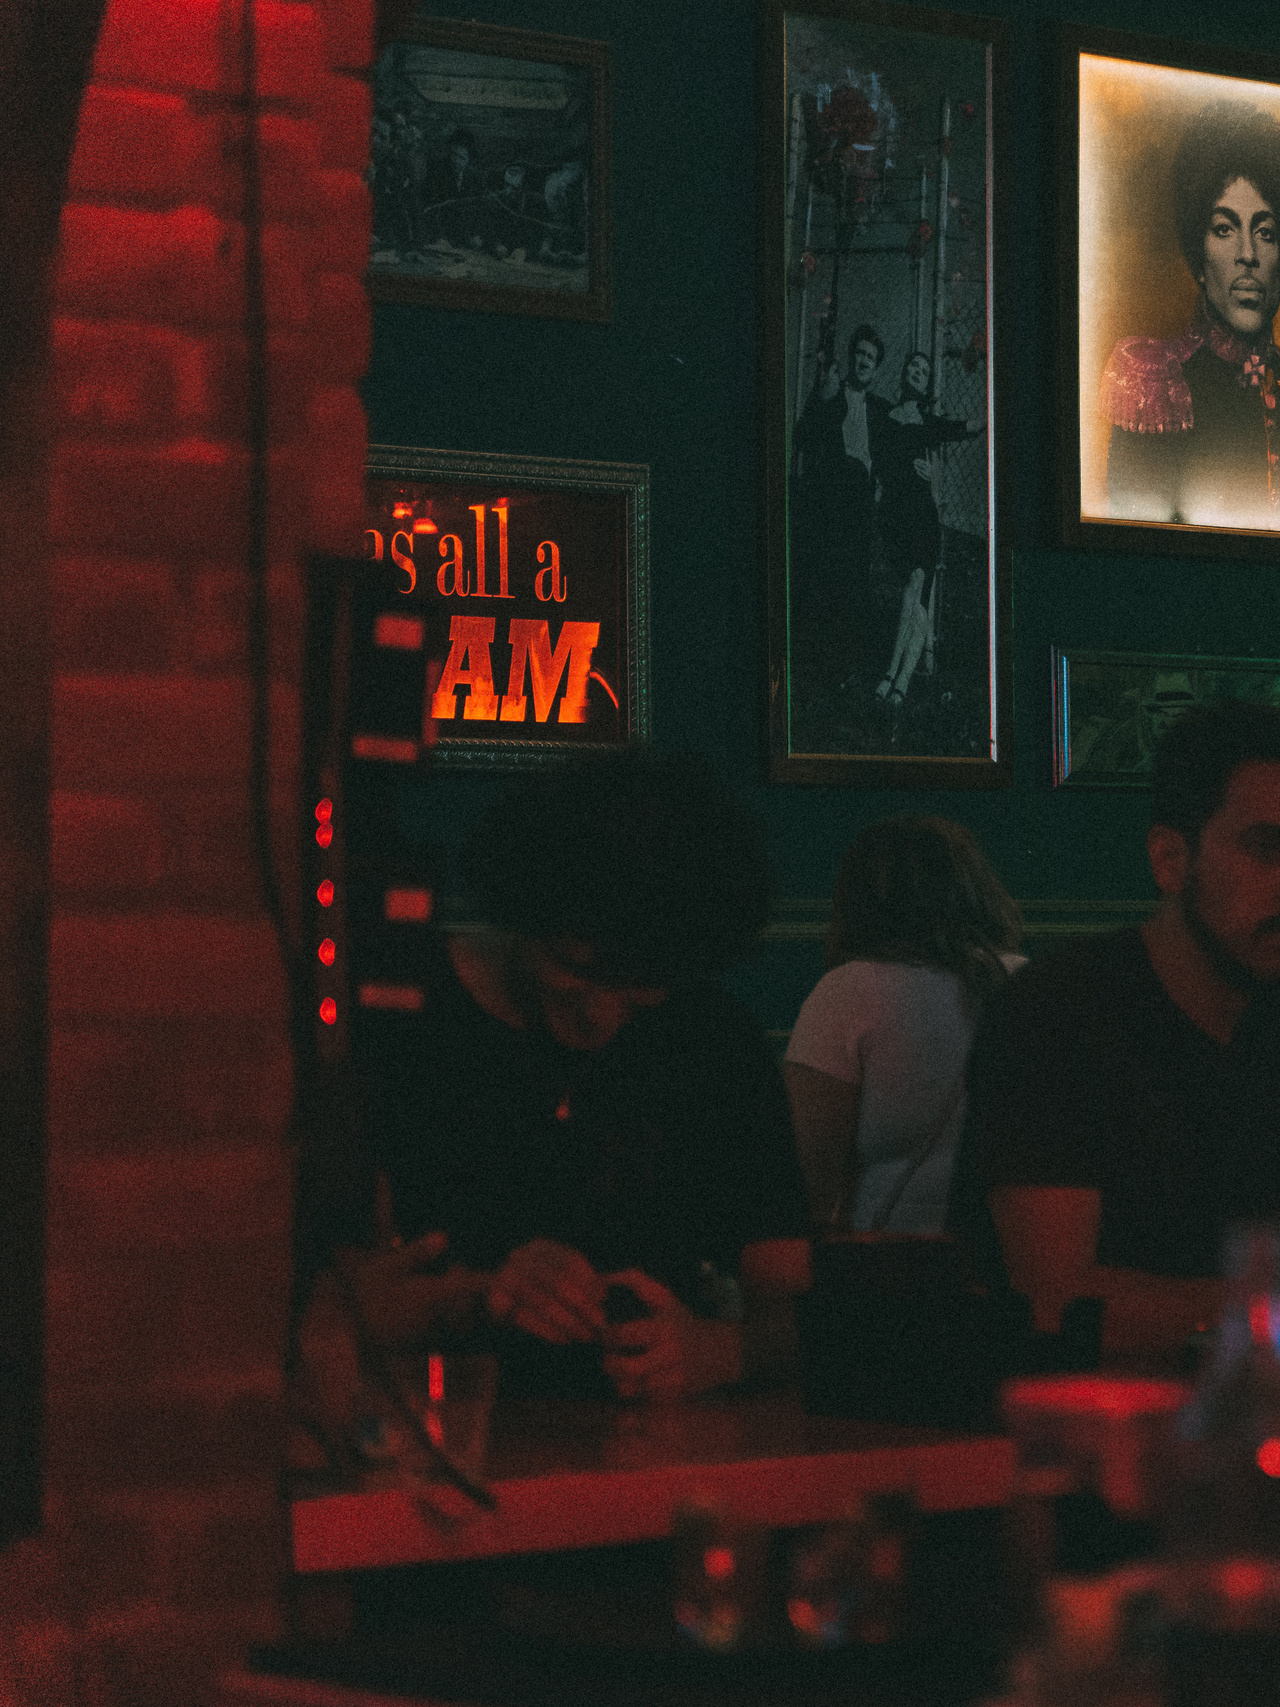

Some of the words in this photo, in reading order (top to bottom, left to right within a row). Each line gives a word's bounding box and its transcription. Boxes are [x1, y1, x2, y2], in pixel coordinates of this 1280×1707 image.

[437, 504, 515, 598] all
[534, 540, 567, 602] a
[431, 615, 600, 723] AM
